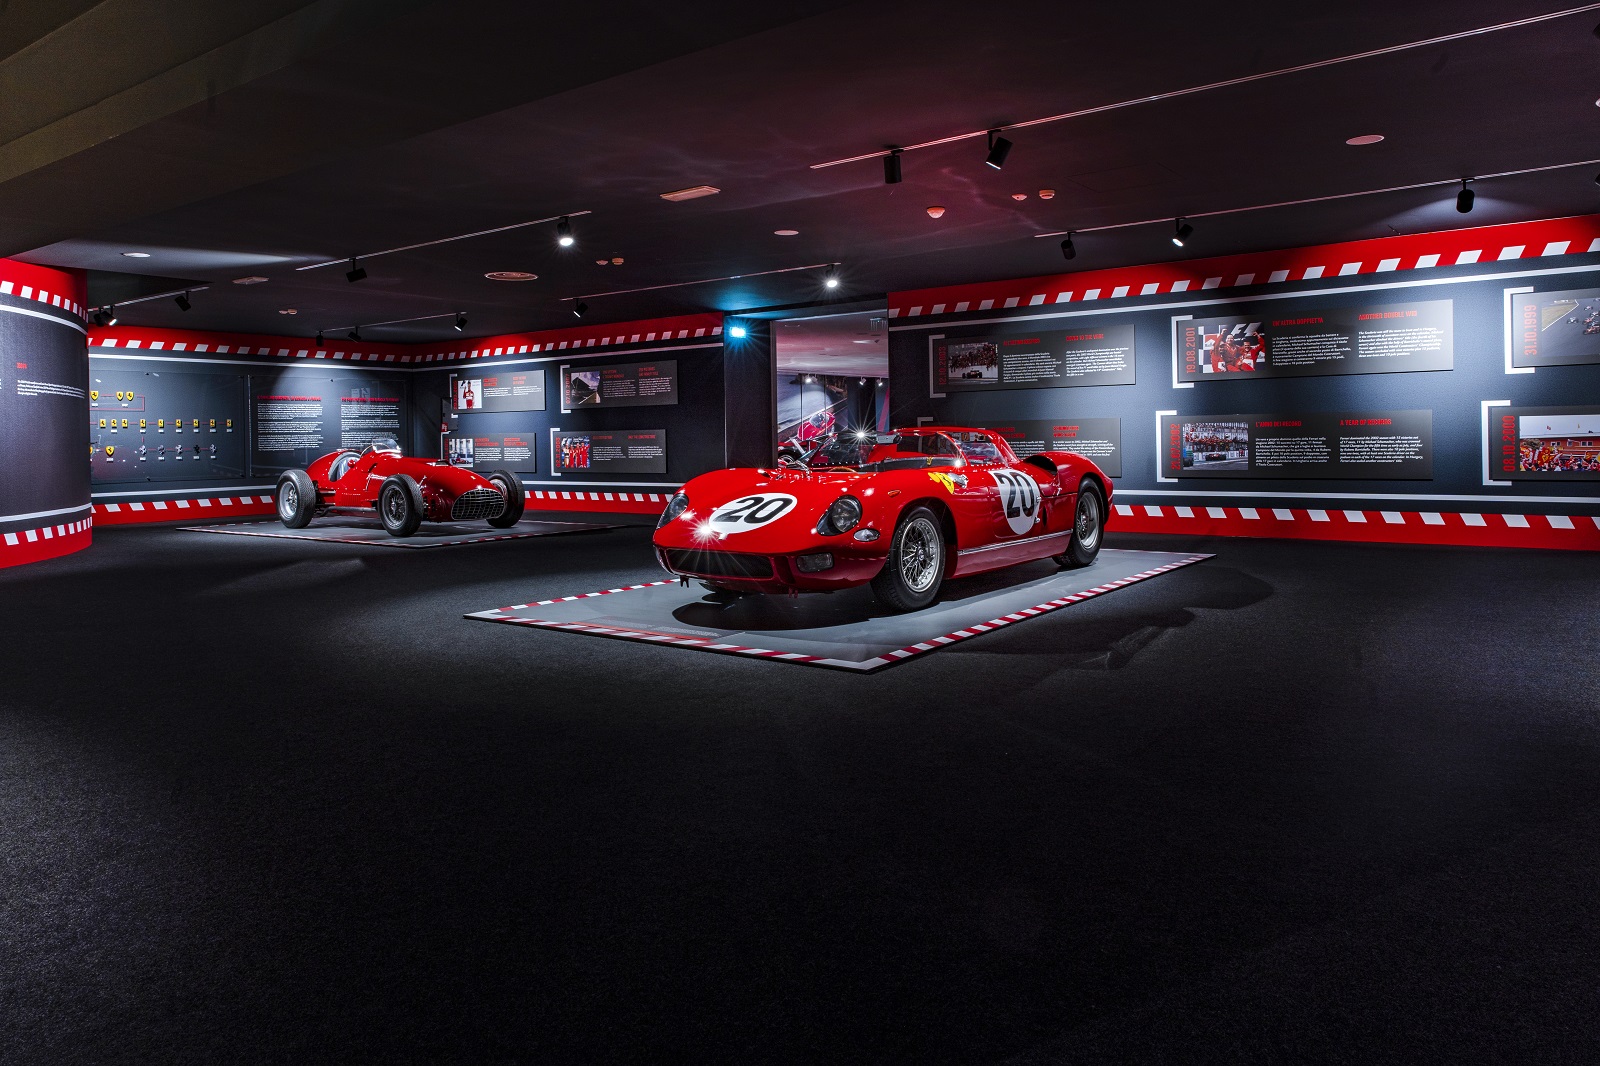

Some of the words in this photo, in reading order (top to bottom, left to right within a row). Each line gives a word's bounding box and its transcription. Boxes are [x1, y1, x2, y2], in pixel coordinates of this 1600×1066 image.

[1185, 327, 1196, 374] 19.08.2001
[1523, 304, 1537, 356] 31.10.1999
[1170, 423, 1180, 470] 21.07.2002
[1502, 415, 1515, 472] 08.10.2000
[713, 496, 793, 524] 20
[993, 471, 1035, 519] 20
